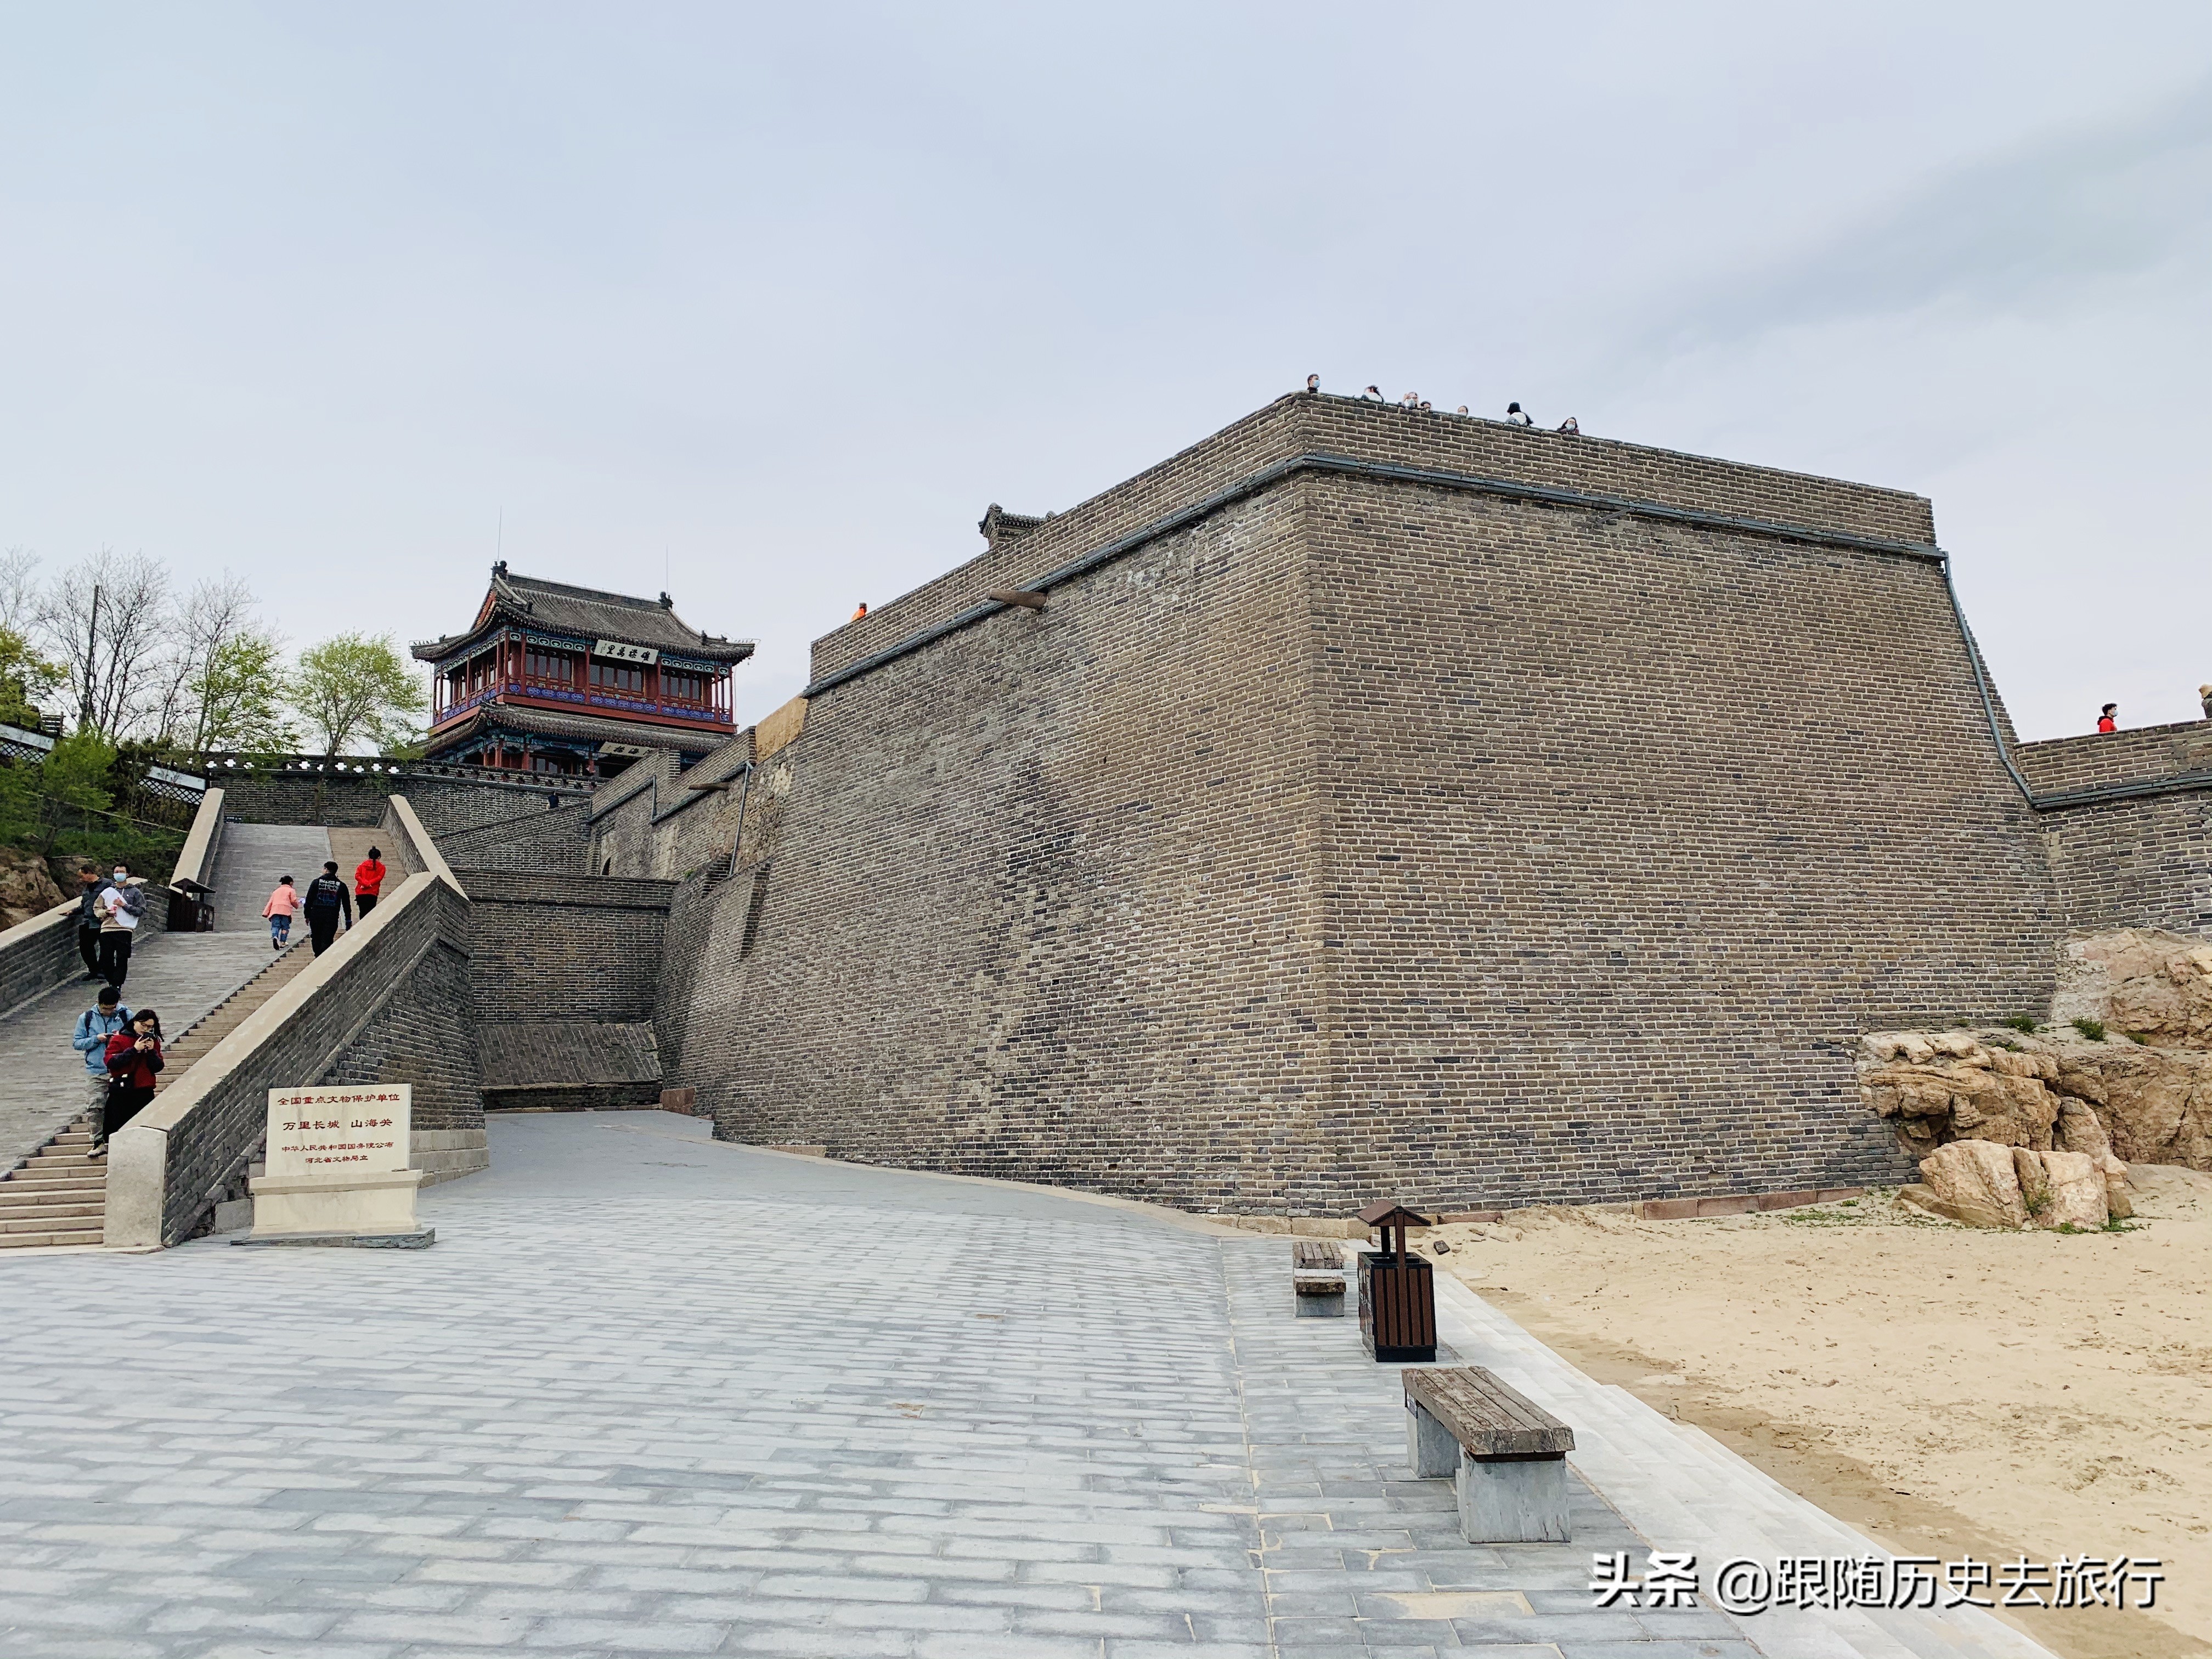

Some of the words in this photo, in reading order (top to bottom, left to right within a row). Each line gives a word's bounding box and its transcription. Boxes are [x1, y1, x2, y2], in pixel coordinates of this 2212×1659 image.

[277, 1093, 400, 1105] 全国重点文物保护单位
[283, 1120, 340, 1131] 万里长城
[351, 1118, 393, 1128] 山海关
[281, 1142, 394, 1152] 中华人民共和国国务院公布
[305, 1155, 369, 1164] 河北省文物局立
